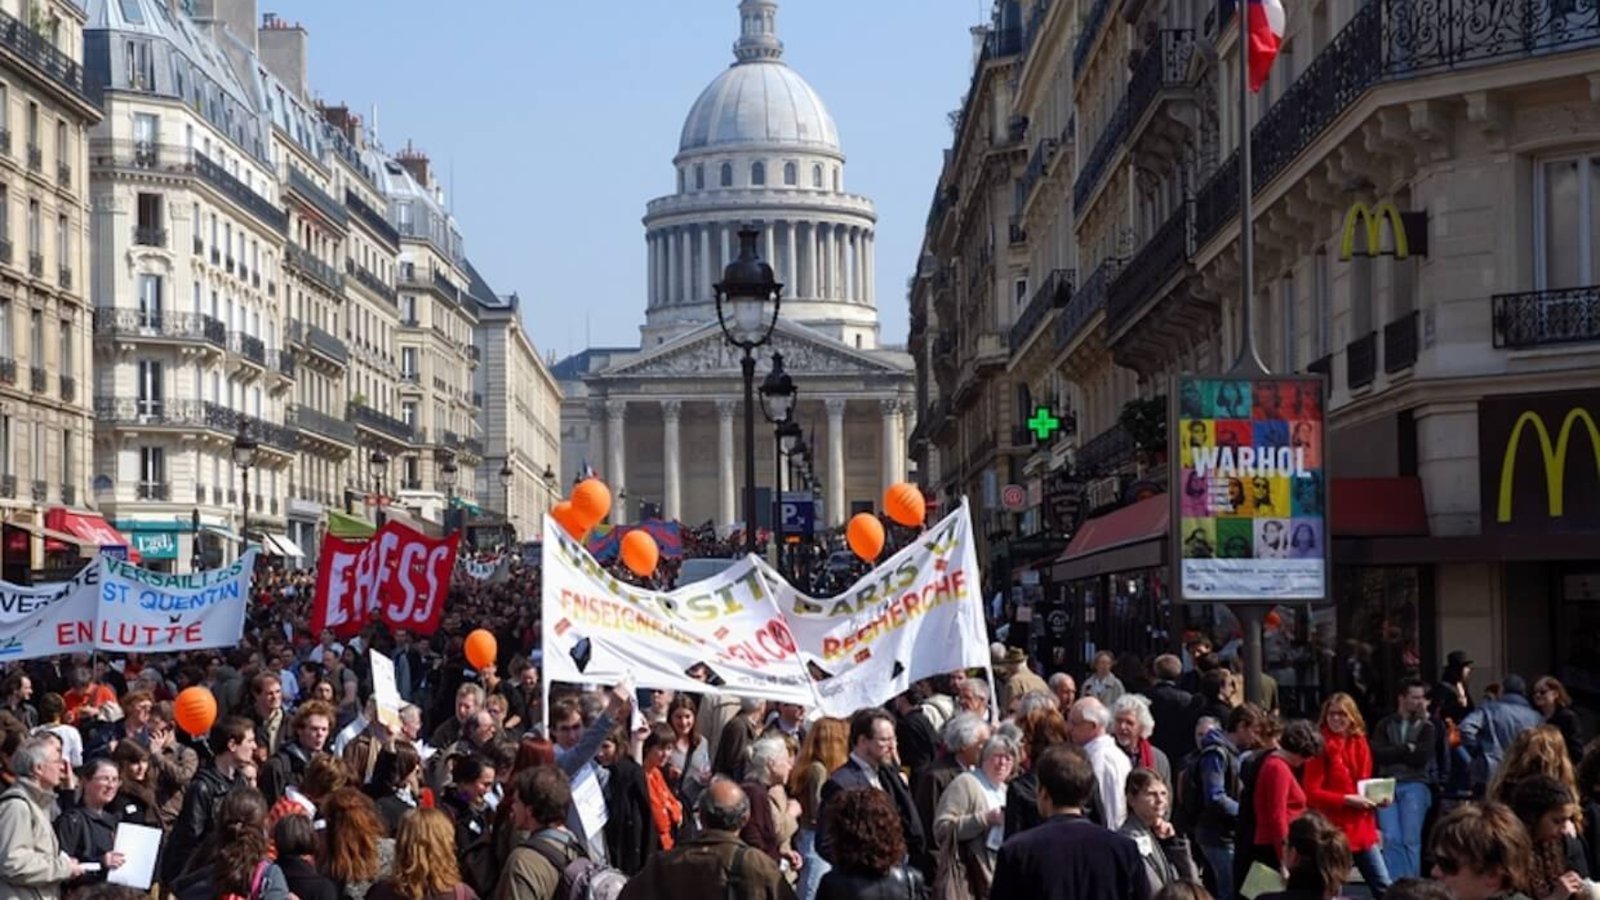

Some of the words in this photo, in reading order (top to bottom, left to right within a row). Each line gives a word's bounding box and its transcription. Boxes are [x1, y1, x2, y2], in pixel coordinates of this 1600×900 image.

[1192, 446, 1311, 477] WARHOL
[781, 503, 797, 524] P
[325, 531, 449, 627] EHESS
[103, 582, 130, 604] ST
[140, 581, 240, 611] QUENTIN
[57, 620, 94, 646] EN
[101, 620, 204, 646] LUTTE
